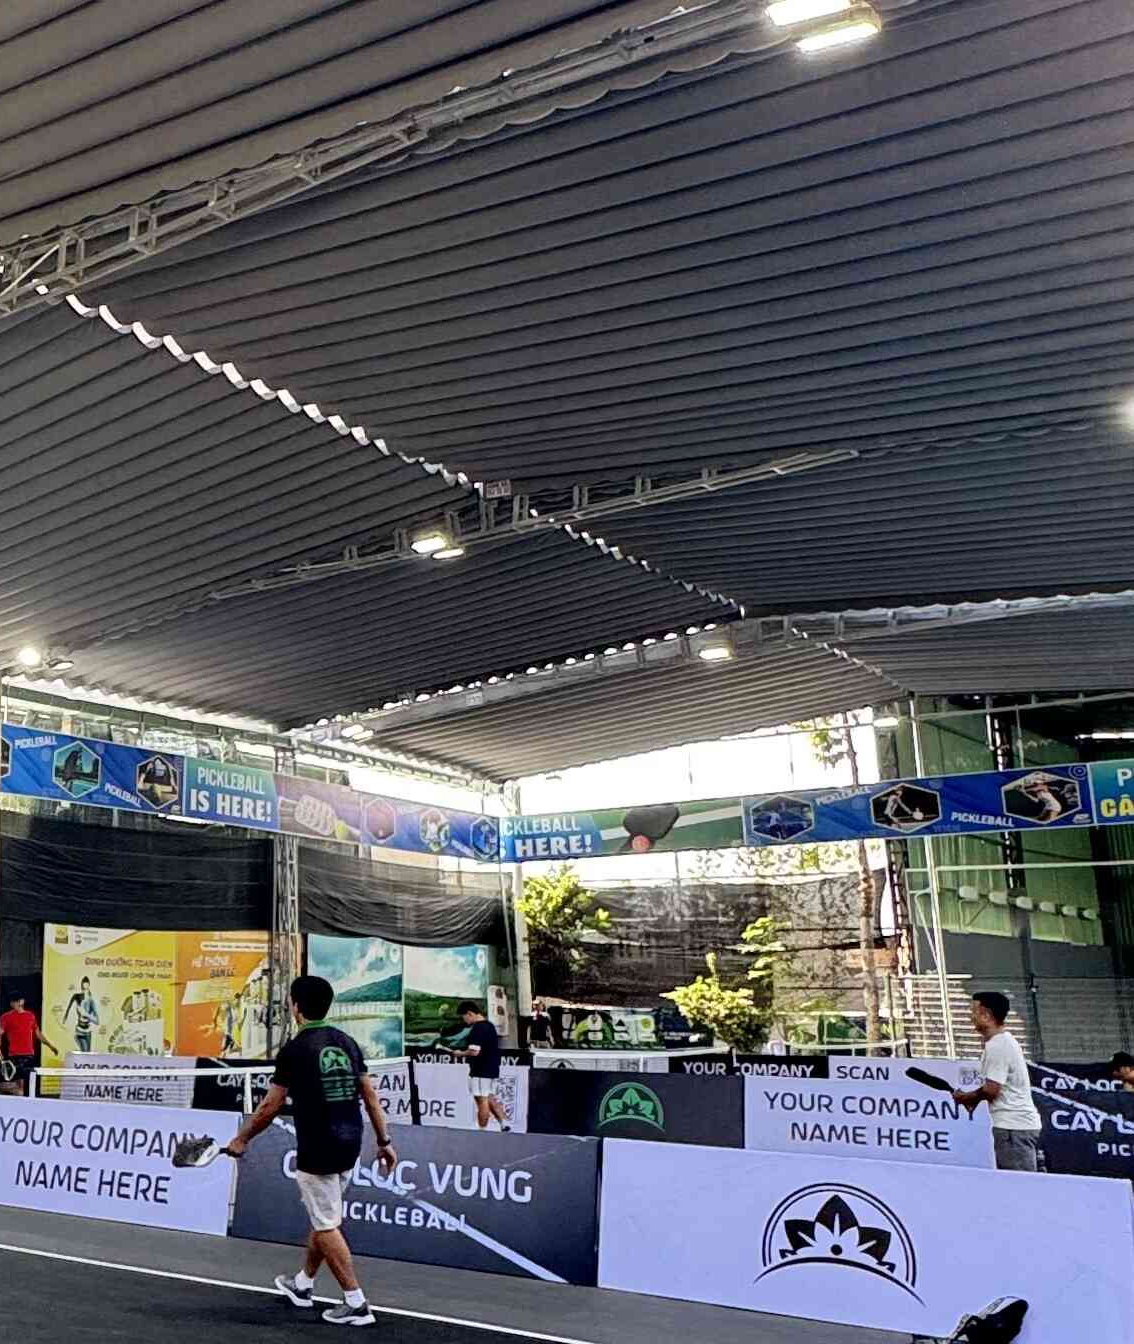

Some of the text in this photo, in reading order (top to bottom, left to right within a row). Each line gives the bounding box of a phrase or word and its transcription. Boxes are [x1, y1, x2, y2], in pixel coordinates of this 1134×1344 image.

[14, 734, 57, 750] PICKLEBALL
[197, 766, 265, 795] PICKLEBALL
[104, 782, 142, 808] PICKLEBALL
[190, 788, 272, 822] IS HERE!
[1100, 794, 1134, 818] CÂ
[502, 815, 580, 836] ICKLEBALL
[951, 810, 1015, 827] PICKLEBALL
[514, 834, 592, 857] HERE!
[683, 1061, 726, 1076] YOUR
[836, 1064, 890, 1081] SCAN
[84, 1084, 165, 1102] NAME HERE
[763, 1090, 834, 1114] YOUR
[1050, 1110, 1103, 1133] CAY
[791, 1121, 951, 1152] NAME HERE
[15, 1160, 171, 1205] NAME HERE
[428, 1161, 533, 1204] VUNG
[342, 1200, 467, 1232] ICKLEBALL
